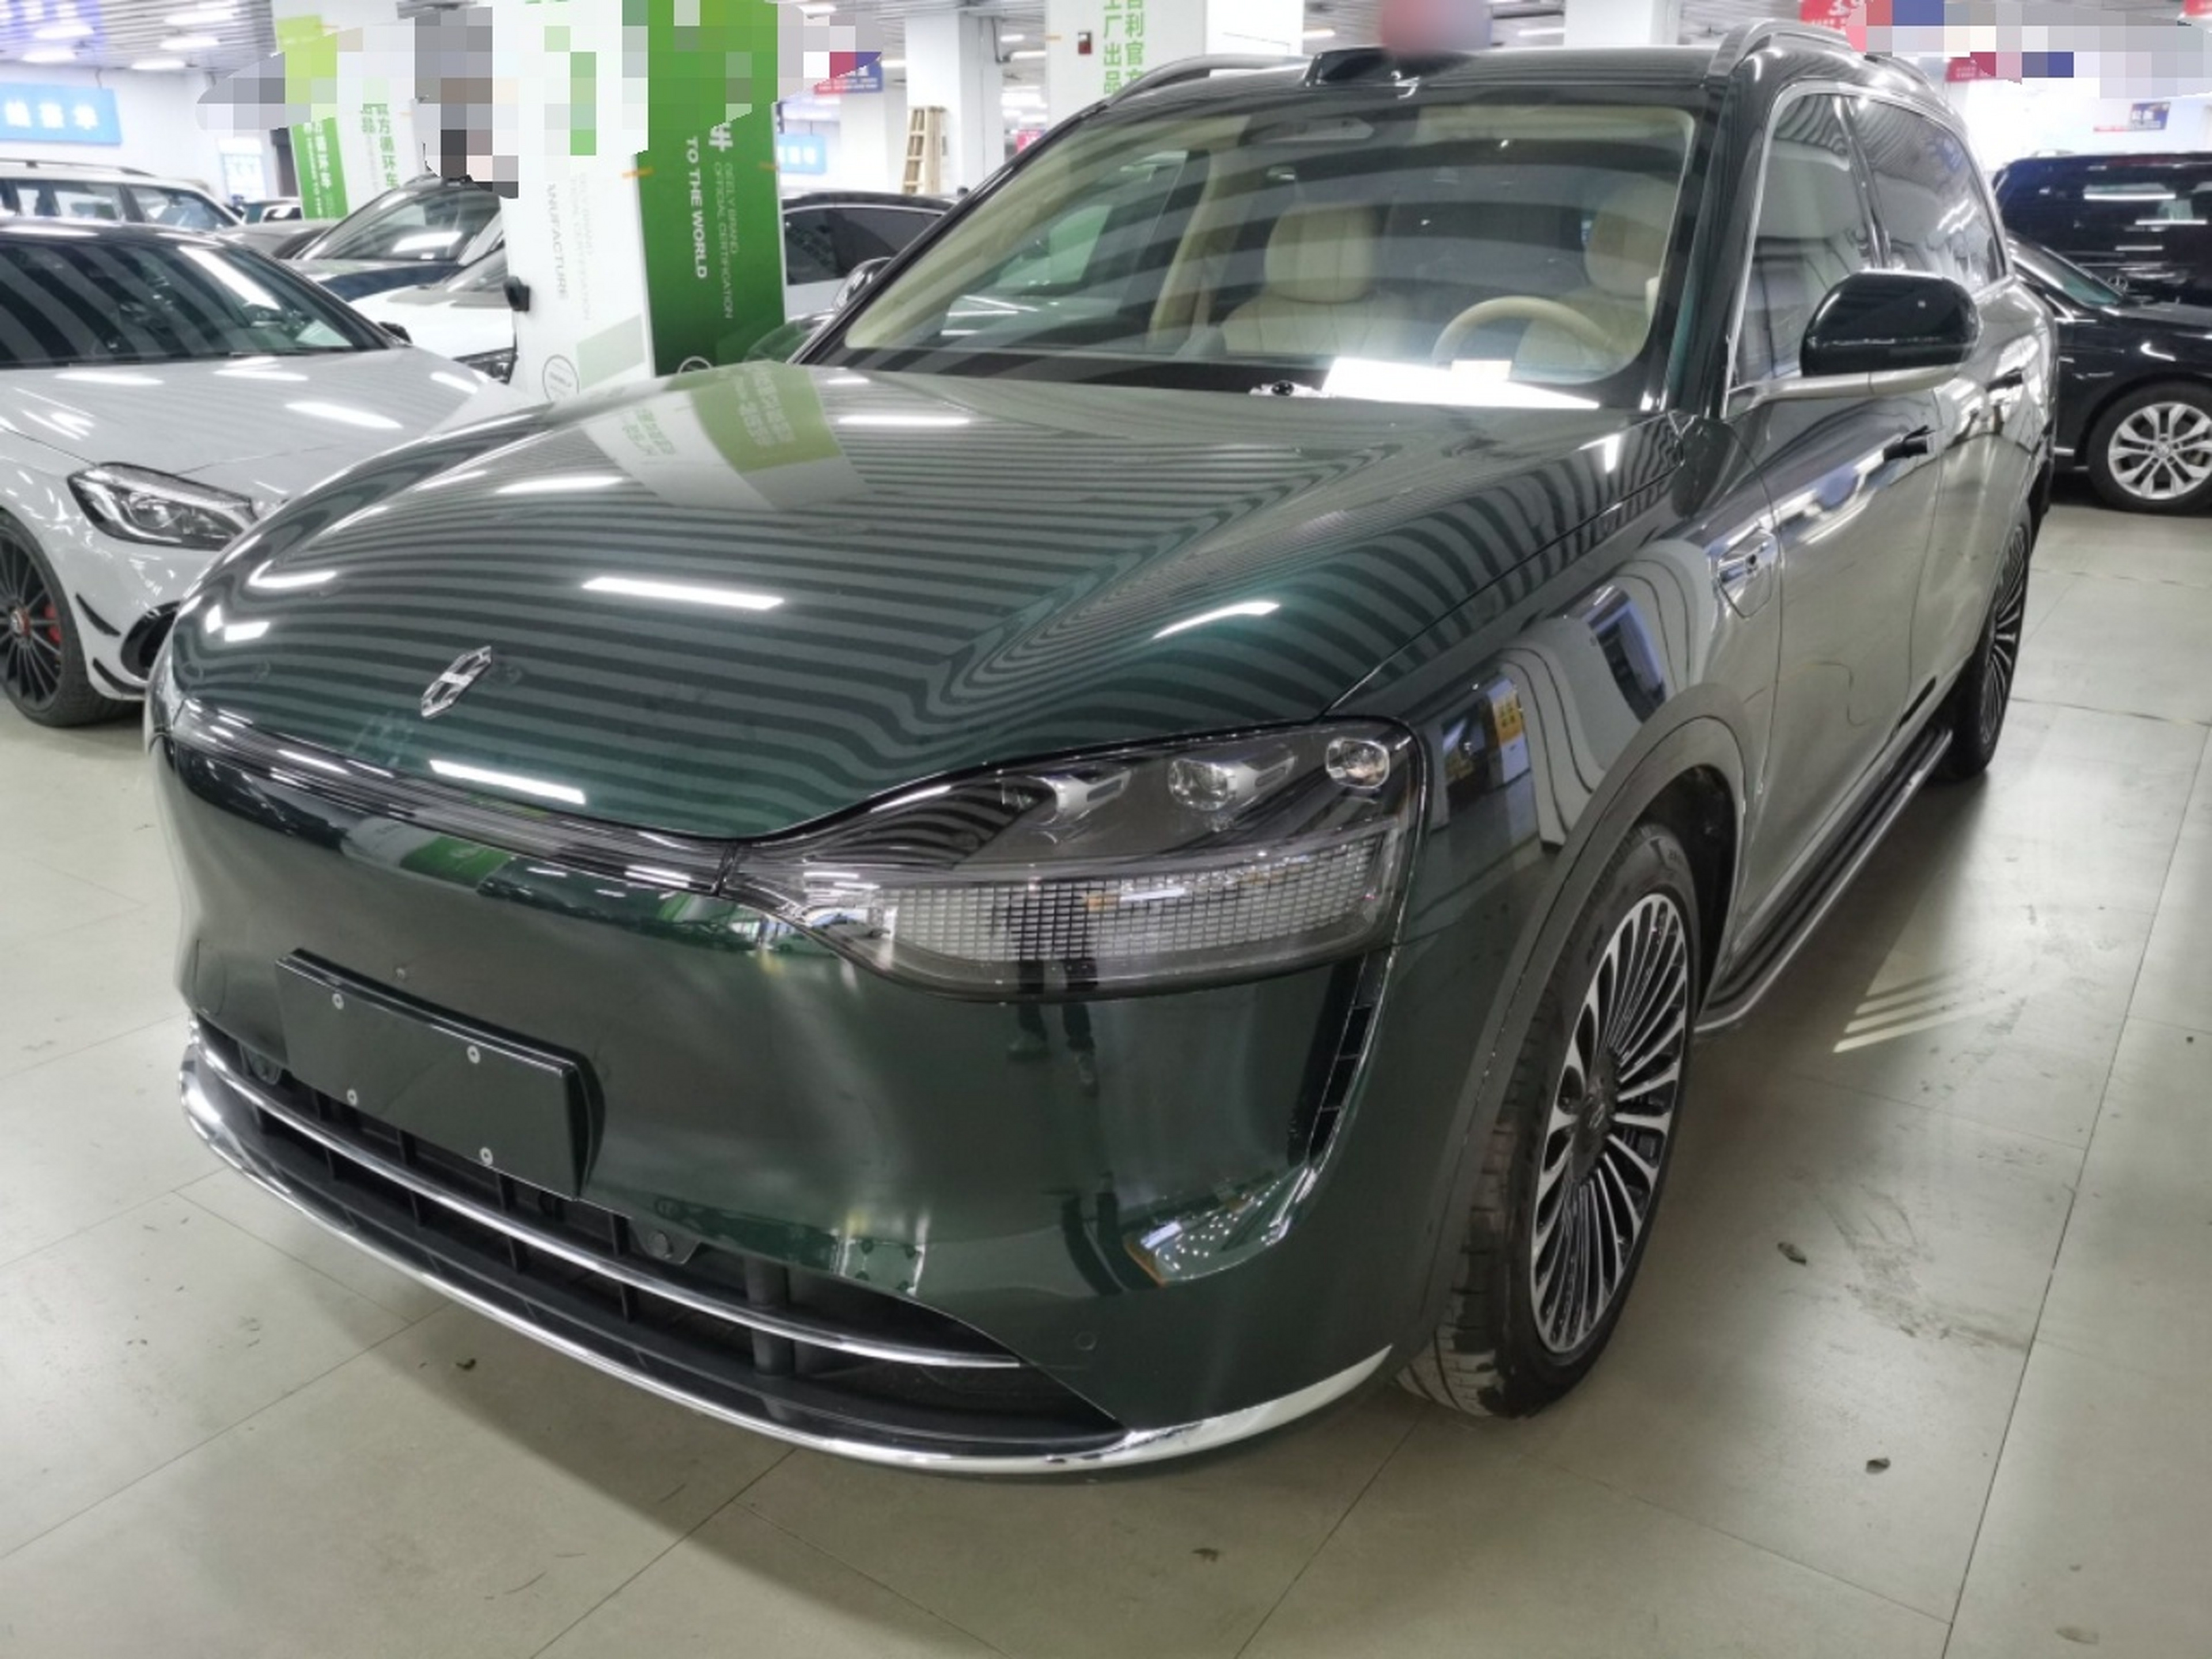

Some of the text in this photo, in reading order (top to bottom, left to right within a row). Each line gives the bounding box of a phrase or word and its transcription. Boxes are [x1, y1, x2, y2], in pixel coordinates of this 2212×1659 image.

[686, 136, 707, 279] TO THE WORLD
